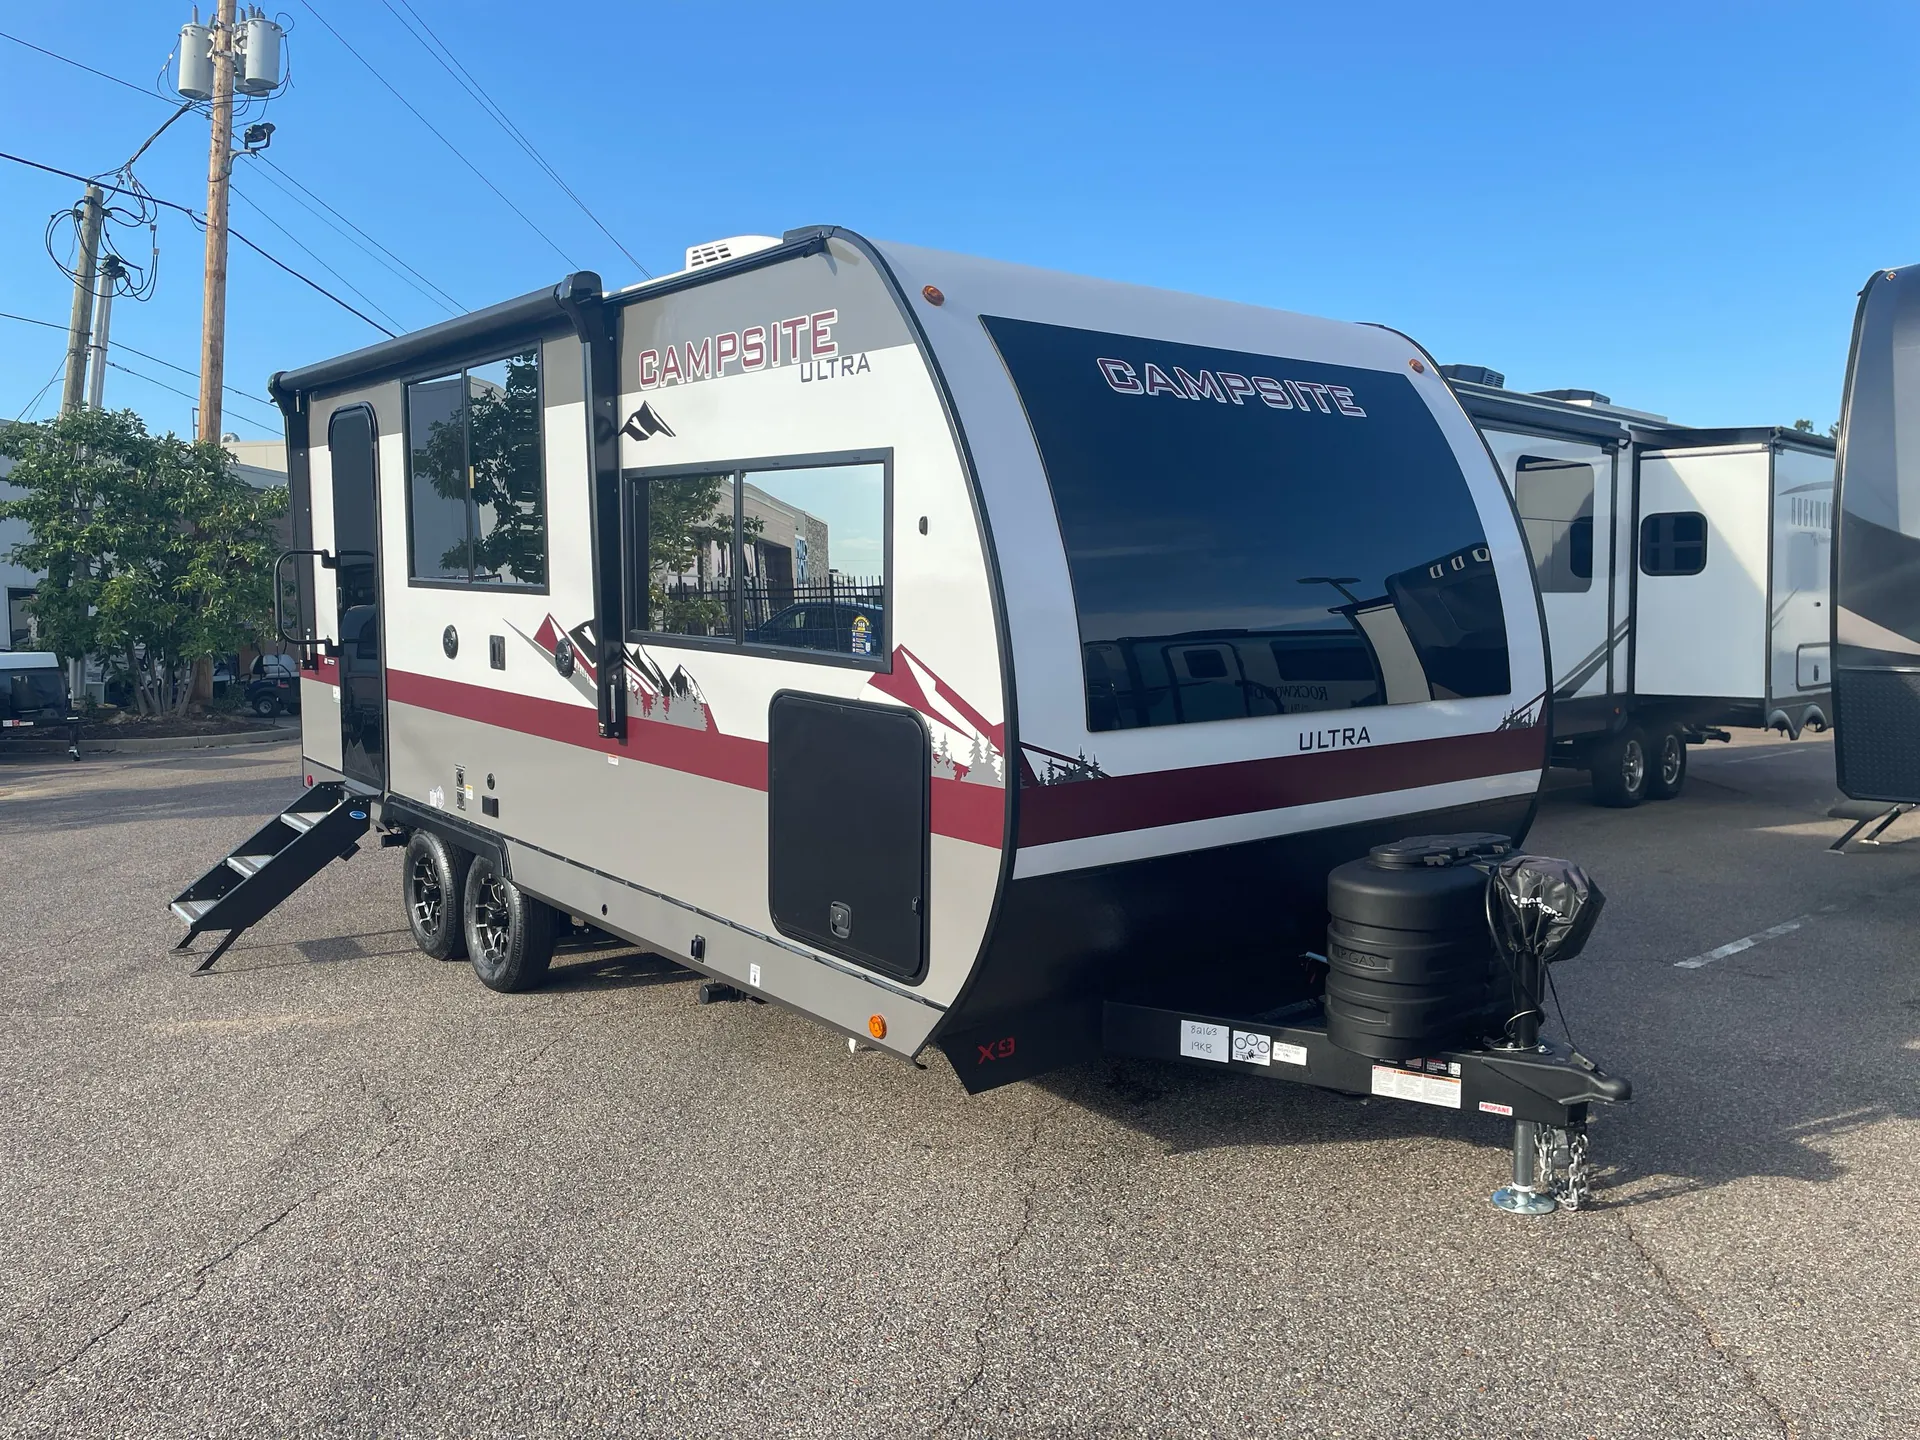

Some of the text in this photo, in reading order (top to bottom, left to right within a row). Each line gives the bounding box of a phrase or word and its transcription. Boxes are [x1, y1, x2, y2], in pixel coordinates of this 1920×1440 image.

[638, 308, 838, 390] CAMPSITE
[800, 352, 871, 383] ULTRA
[1096, 357, 1368, 418] CAMPSITE
[1299, 726, 1371, 751] ULTRA
[1349, 951, 1376, 968] GAS
[1190, 1025, 1218, 1036] 82163
[1480, 1103, 1510, 1115] PROPANE
